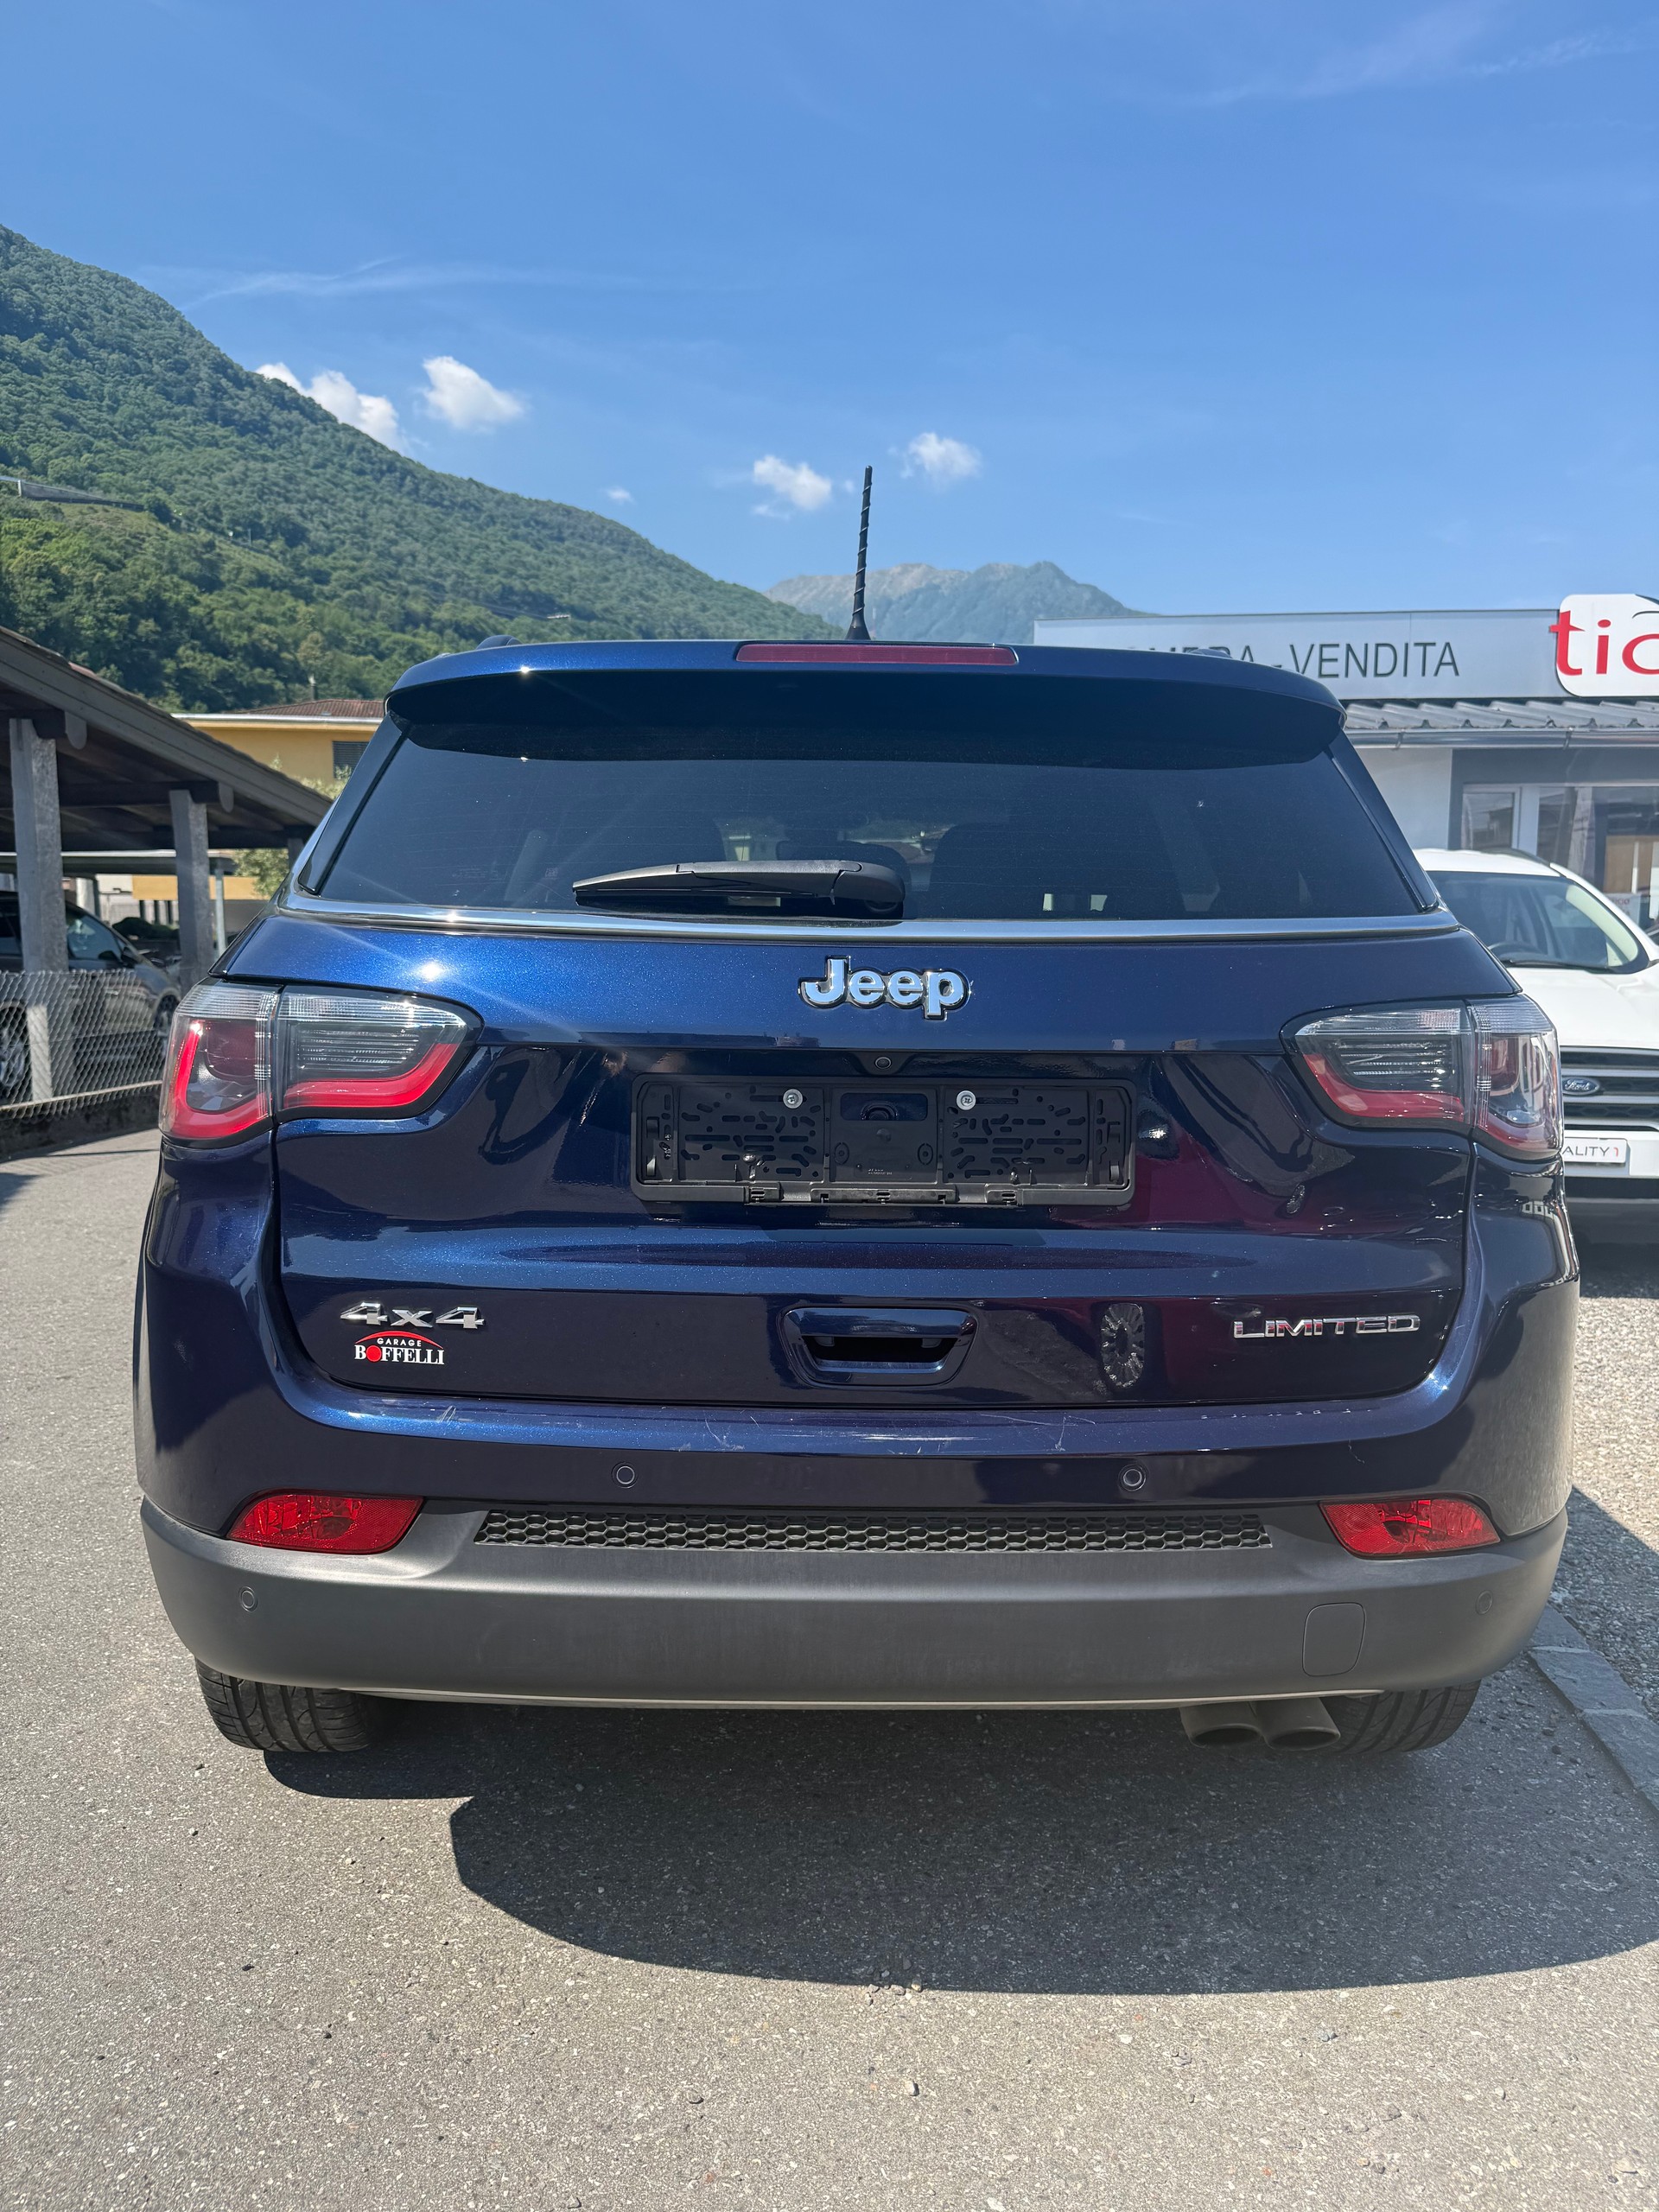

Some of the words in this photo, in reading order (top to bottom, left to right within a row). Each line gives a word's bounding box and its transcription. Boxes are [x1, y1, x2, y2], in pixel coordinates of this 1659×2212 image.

[1289, 642, 1460, 679] VENDITA
[800, 957, 968, 1018] Jeep
[1564, 1079, 1592, 1091] Ford
[1562, 1145, 1610, 1157] ALITY
[340, 1301, 485, 1331] 4x4
[1233, 1314, 1421, 1338] LIMITED
[377, 1338, 422, 1347] GARAGE
